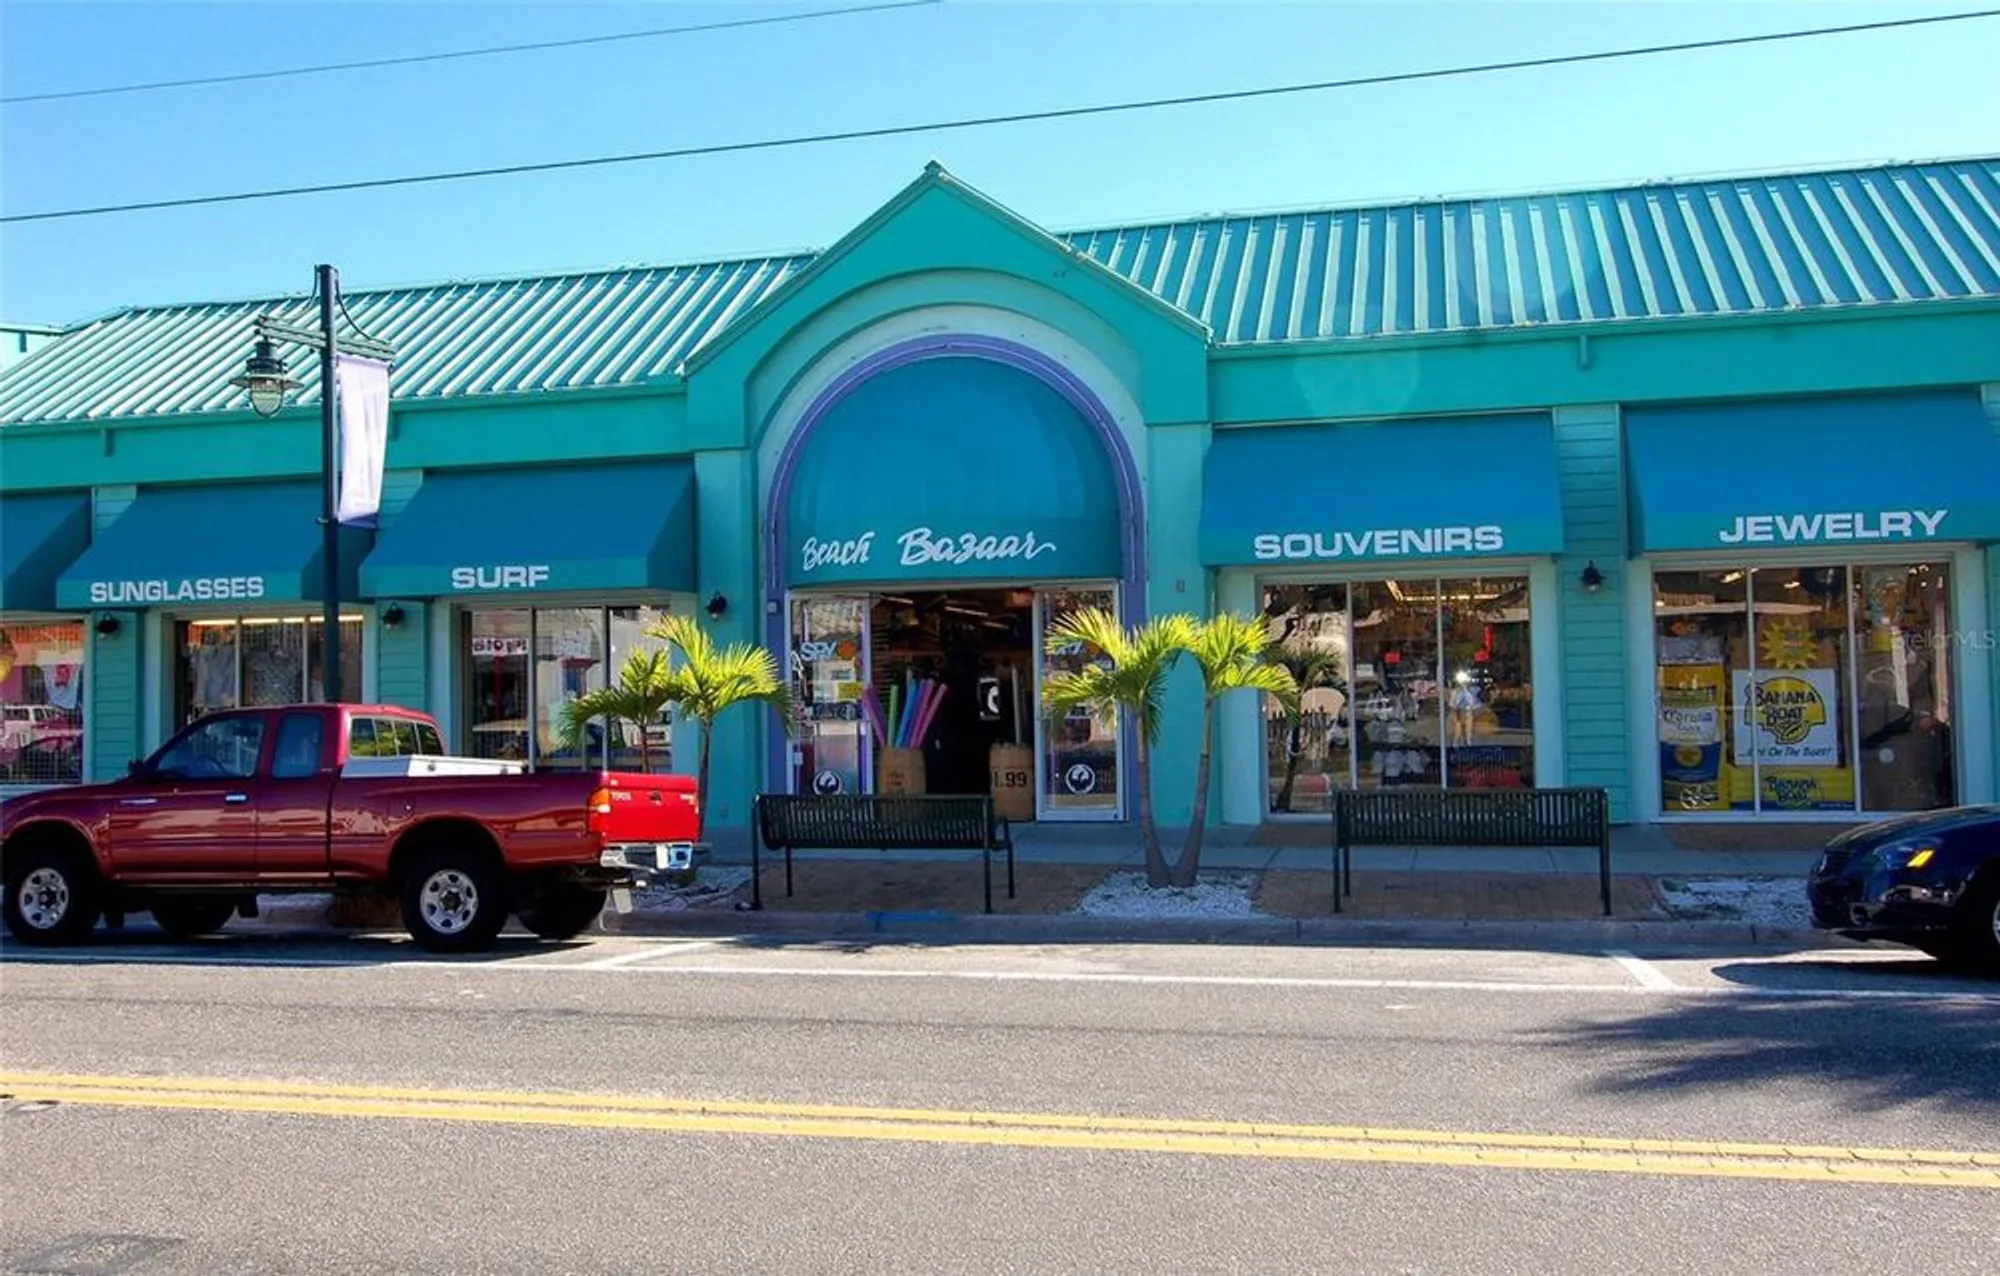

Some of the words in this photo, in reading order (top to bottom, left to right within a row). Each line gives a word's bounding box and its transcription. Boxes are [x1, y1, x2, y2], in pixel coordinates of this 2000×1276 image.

[1719, 509, 1946, 542] JEWELRY
[802, 531, 875, 571] Beach
[898, 527, 1057, 567] Bazaar
[1254, 525, 1503, 559] SOUVENIRS
[90, 576, 265, 603] SUNGLASSES
[451, 565, 550, 590] SURF
[800, 641, 837, 661] SPY
[1745, 682, 1817, 707] BANANA
[1766, 705, 1807, 726] BOAT
